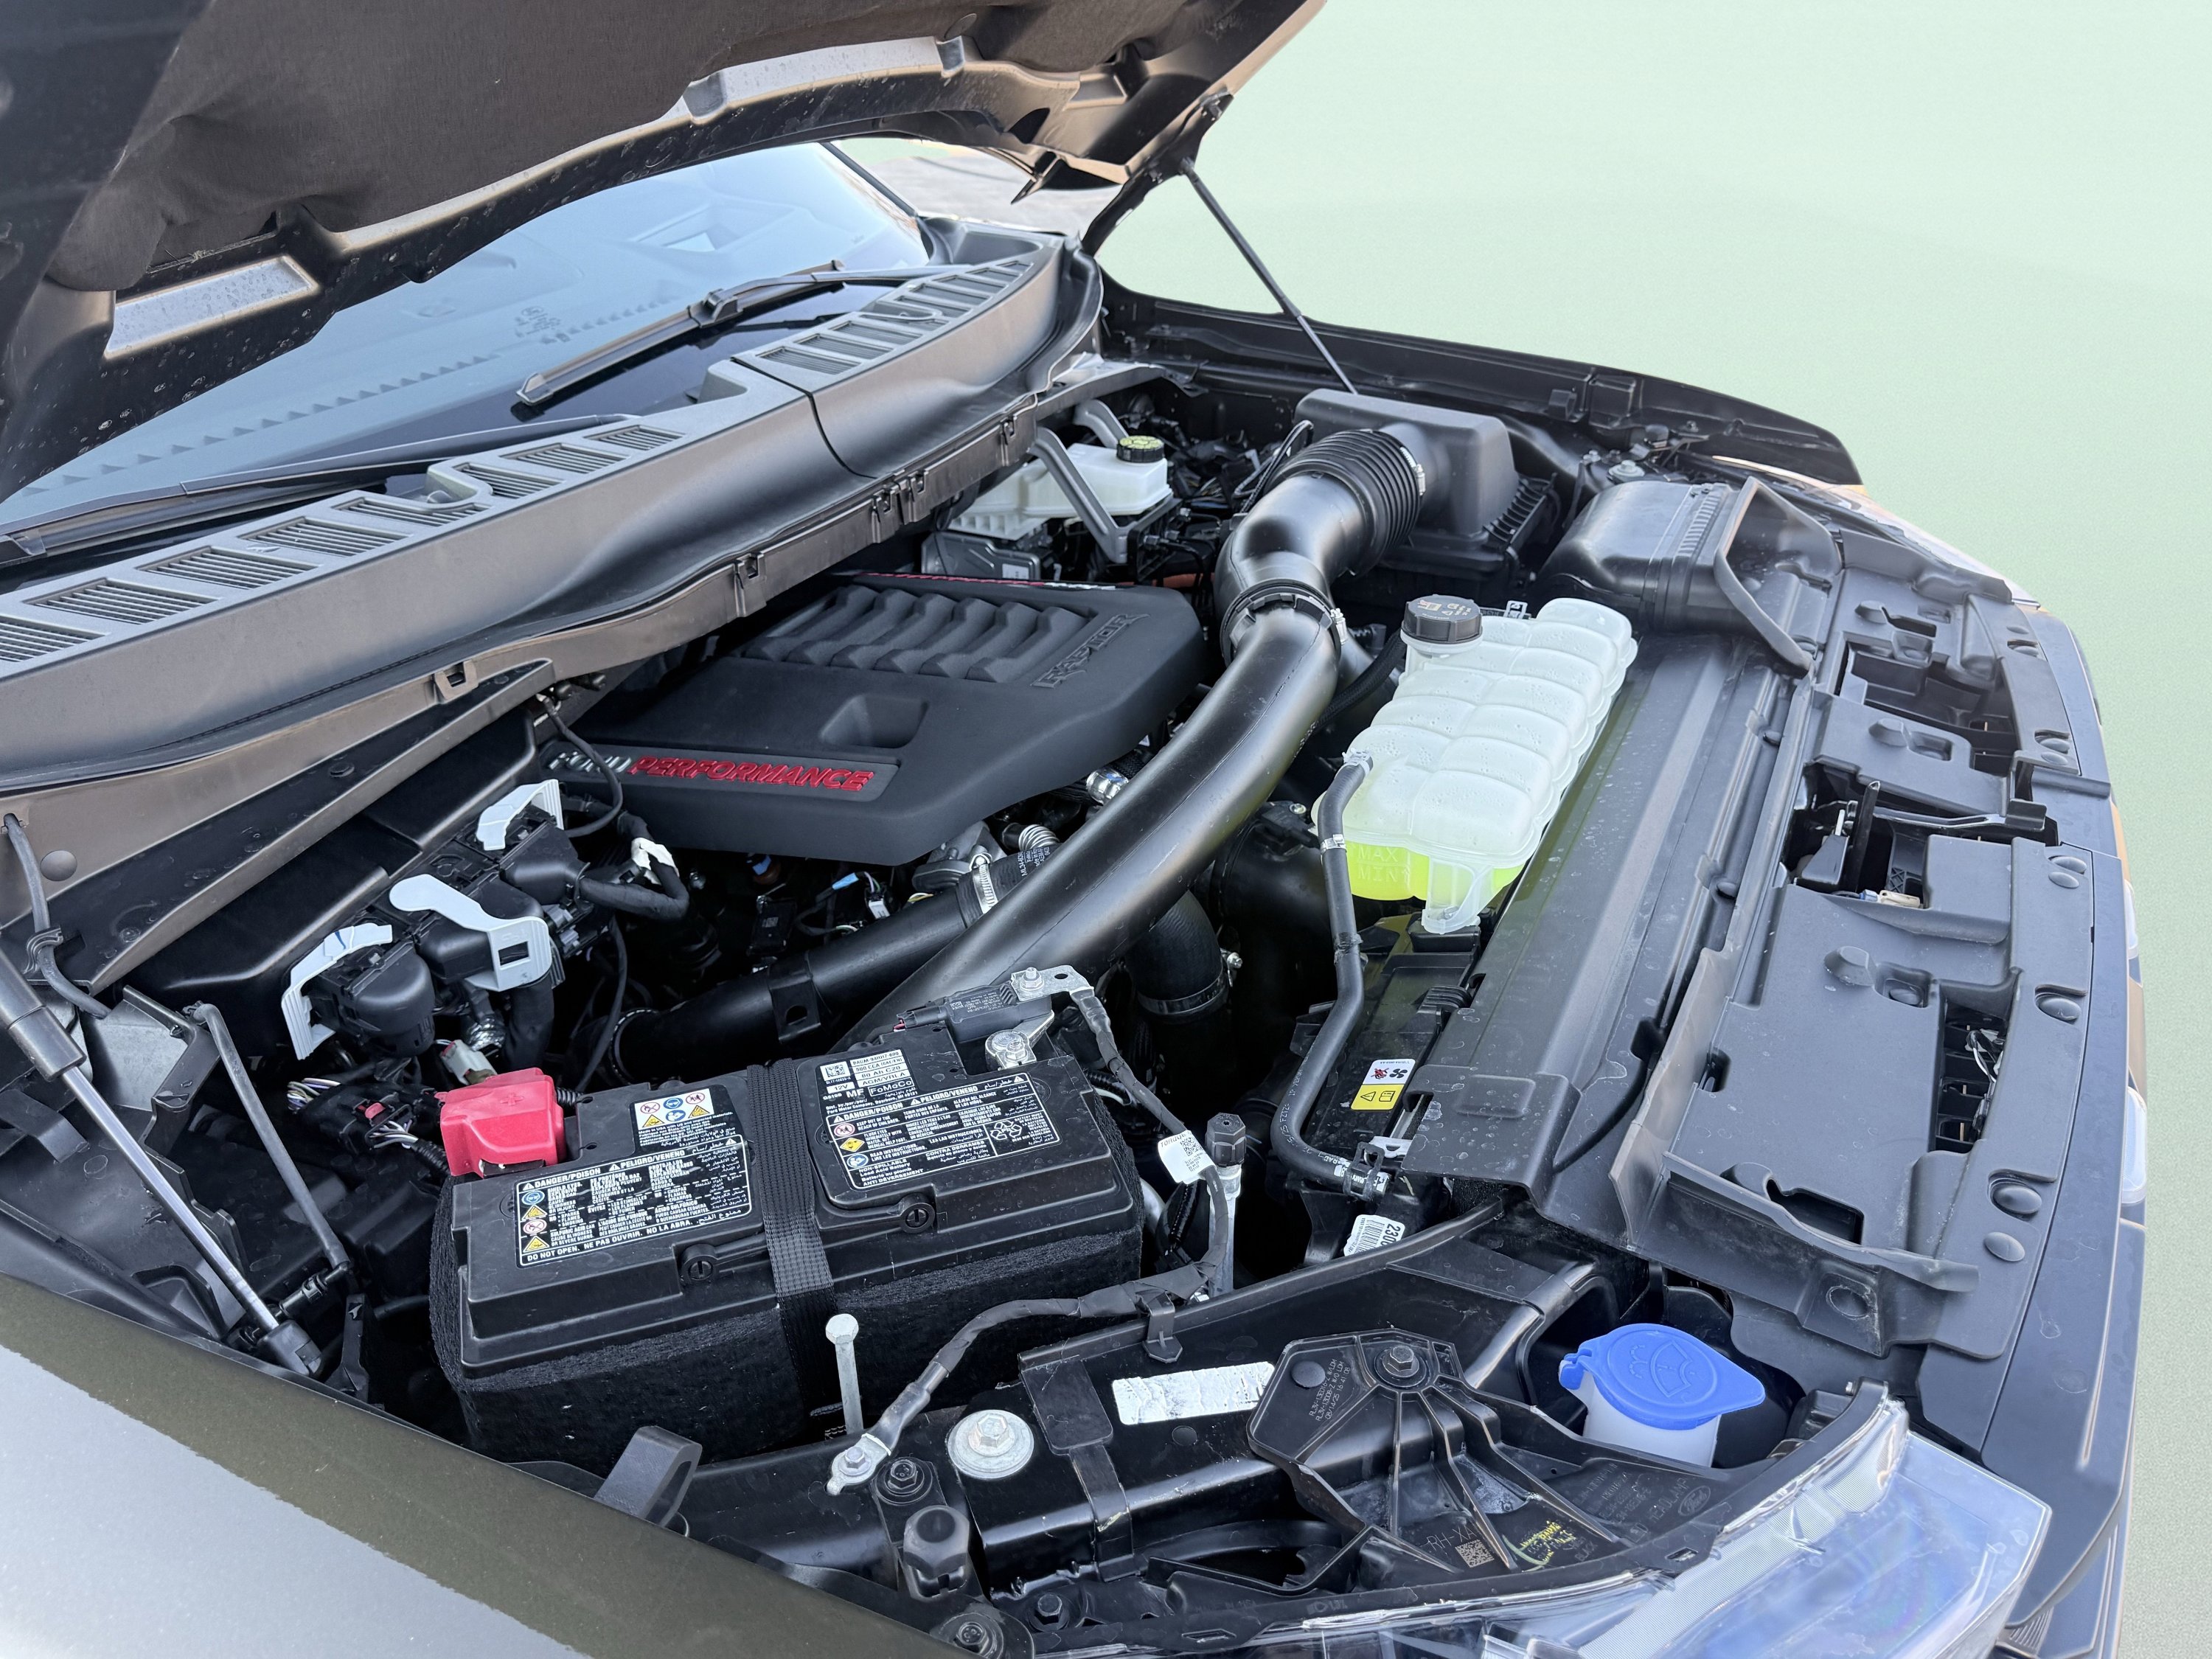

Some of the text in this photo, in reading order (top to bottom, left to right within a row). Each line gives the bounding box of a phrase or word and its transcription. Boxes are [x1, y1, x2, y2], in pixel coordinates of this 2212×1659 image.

[1030, 613, 1150, 689] RAPTOR
[627, 755, 874, 791] PERFORMANCE
[1357, 846, 1399, 862] MAX
[1357, 865, 1399, 882] MIN
[861, 1071, 906, 1085] AGM/VRLA
[885, 1065, 901, 1073] C20
[845, 1088, 865, 1099] MF
[869, 1079, 914, 1094] FoMoCo
[919, 1085, 979, 1103] PELIGRO/VENENO
[826, 1107, 838, 1115] Ford
[838, 1104, 852, 1113] Motor
[851, 1099, 874, 1110] Company,
[874, 1095, 897, 1105] Dearborn,
[842, 1102, 904, 1120] DANGER/POISON
[692, 1116, 712, 1124] imported
[924, 1139, 985, 1157] CONTRA DERRAMES
[620, 1148, 685, 1169] PELIGRO/VENENO
[858, 1158, 908, 1173] NON-SPILLABLE
[534, 1166, 601, 1188] DANGER/POISON
[859, 1169, 875, 1178] Lead
[888, 1161, 911, 1171] Battery
[549, 1222, 595, 1238] SULFURIC ACID CAN
[646, 1218, 693, 1235] NO LA ABRA.
[583, 1229, 643, 1249] NE PAS OUVRIR.
[526, 1244, 580, 1262] DO NOT OPEN.
[1325, 1393, 1340, 1419] 08/14/25
[1426, 1524, 1477, 1551] RH-XA
